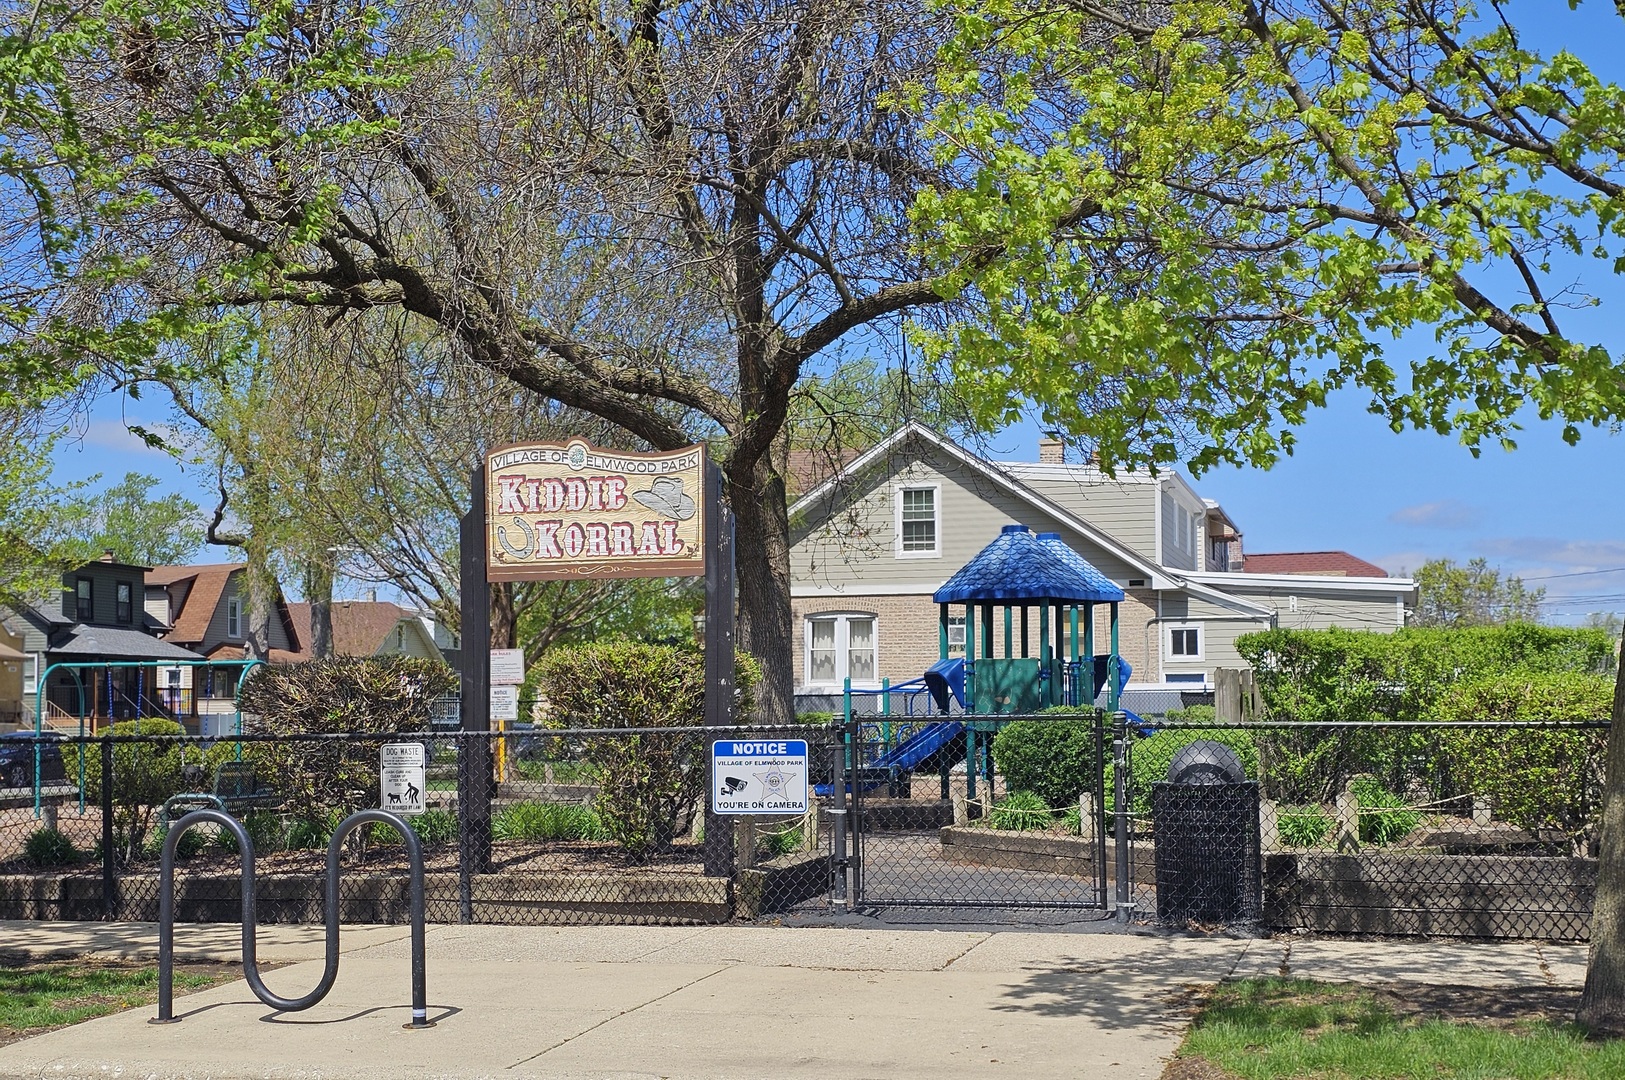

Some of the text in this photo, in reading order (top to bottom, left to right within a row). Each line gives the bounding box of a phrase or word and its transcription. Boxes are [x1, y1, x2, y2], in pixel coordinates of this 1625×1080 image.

[493, 451, 697, 473] VILLAGE OF ELMWOOD PARK
[498, 475, 628, 514] KIDDIE
[535, 519, 685, 559] KORRAL
[733, 743, 787, 754] NOTICE
